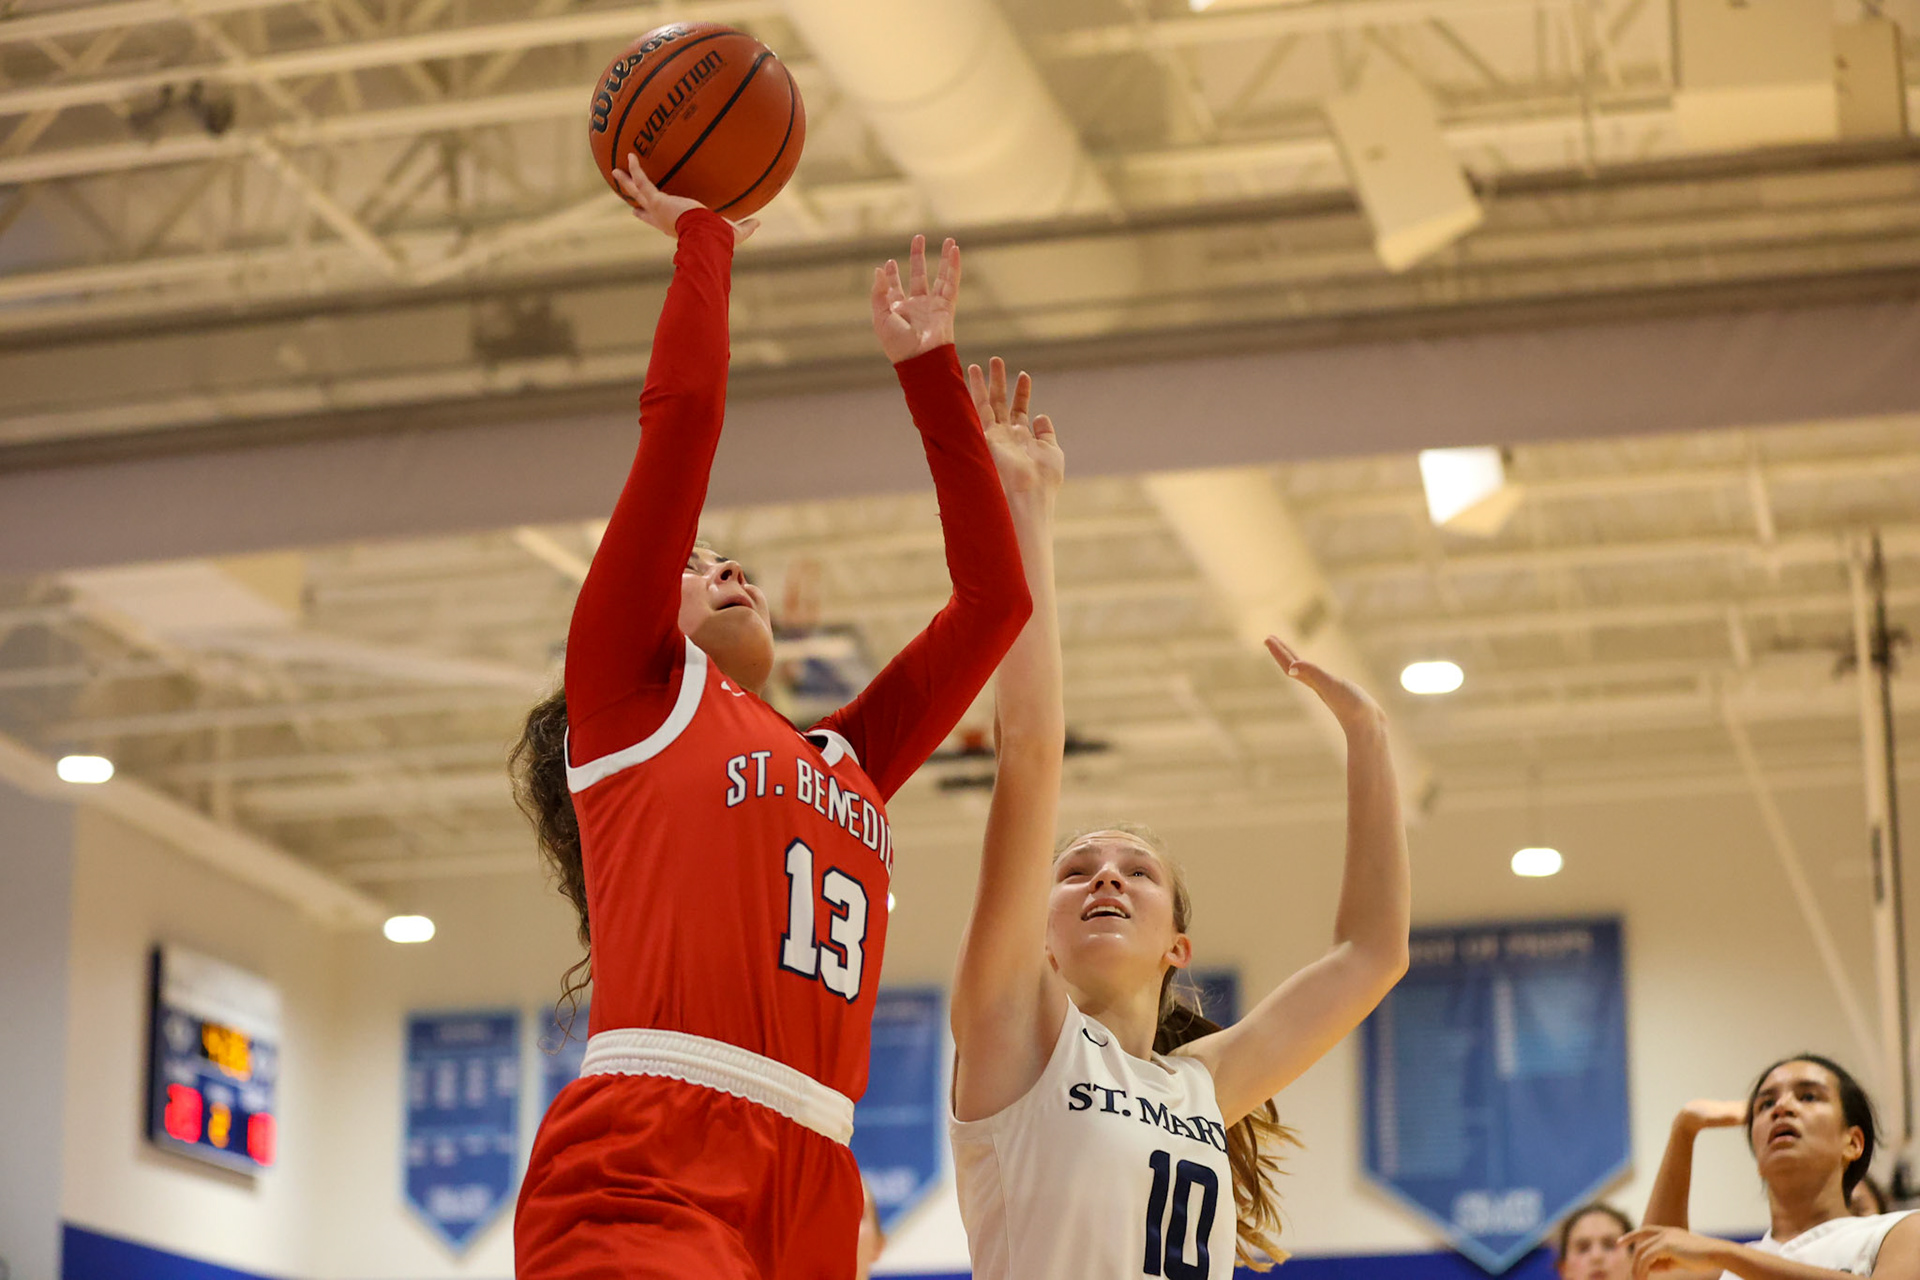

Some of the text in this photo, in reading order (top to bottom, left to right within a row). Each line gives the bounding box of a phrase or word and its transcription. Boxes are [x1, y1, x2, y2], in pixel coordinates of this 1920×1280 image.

[592, 28, 697, 133] Wilson
[633, 50, 722, 157] EVOLUTION
[726, 751, 785, 807] ST.
[779, 837, 869, 1004] 13
[1069, 1083, 1132, 1117] ST.
[1143, 1149, 1219, 1280] 10
